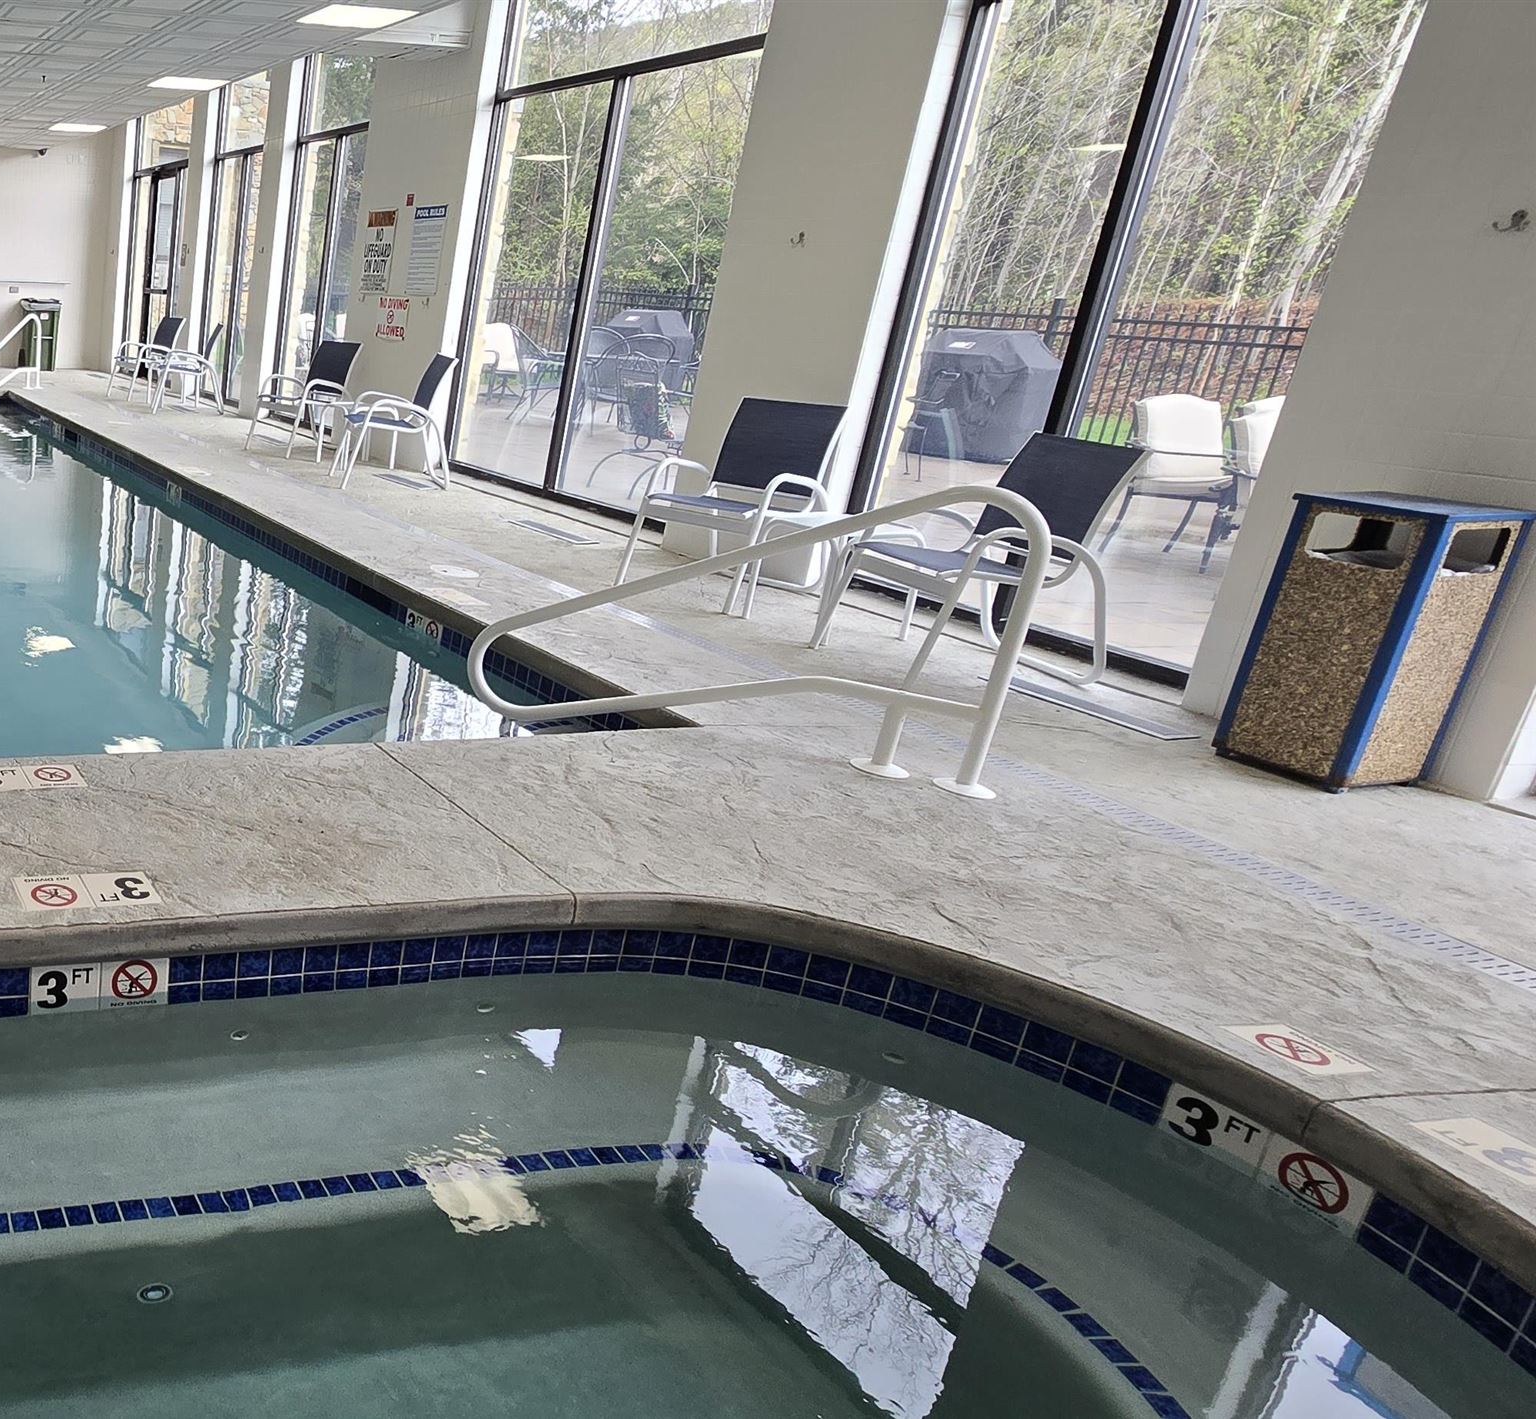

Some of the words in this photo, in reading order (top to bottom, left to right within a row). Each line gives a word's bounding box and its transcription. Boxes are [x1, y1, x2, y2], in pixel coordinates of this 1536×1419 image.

[416, 208, 429, 217] POOL
[429, 207, 445, 216] RULES
[375, 228, 384, 242] NO
[364, 243, 391, 258] LIFEGUARD
[364, 259, 372, 273] ON
[372, 259, 388, 273] DUTY
[379, 297, 387, 308] NO
[387, 298, 409, 310] DIVING
[376, 324, 405, 337] ALLOWED
[114, 877, 151, 900] 3
[100, 892, 121, 903] FT
[37, 970, 68, 1009] 3
[72, 967, 94, 985] FT
[1168, 1096, 1220, 1147] 3
[1224, 1115, 1262, 1144] FT
